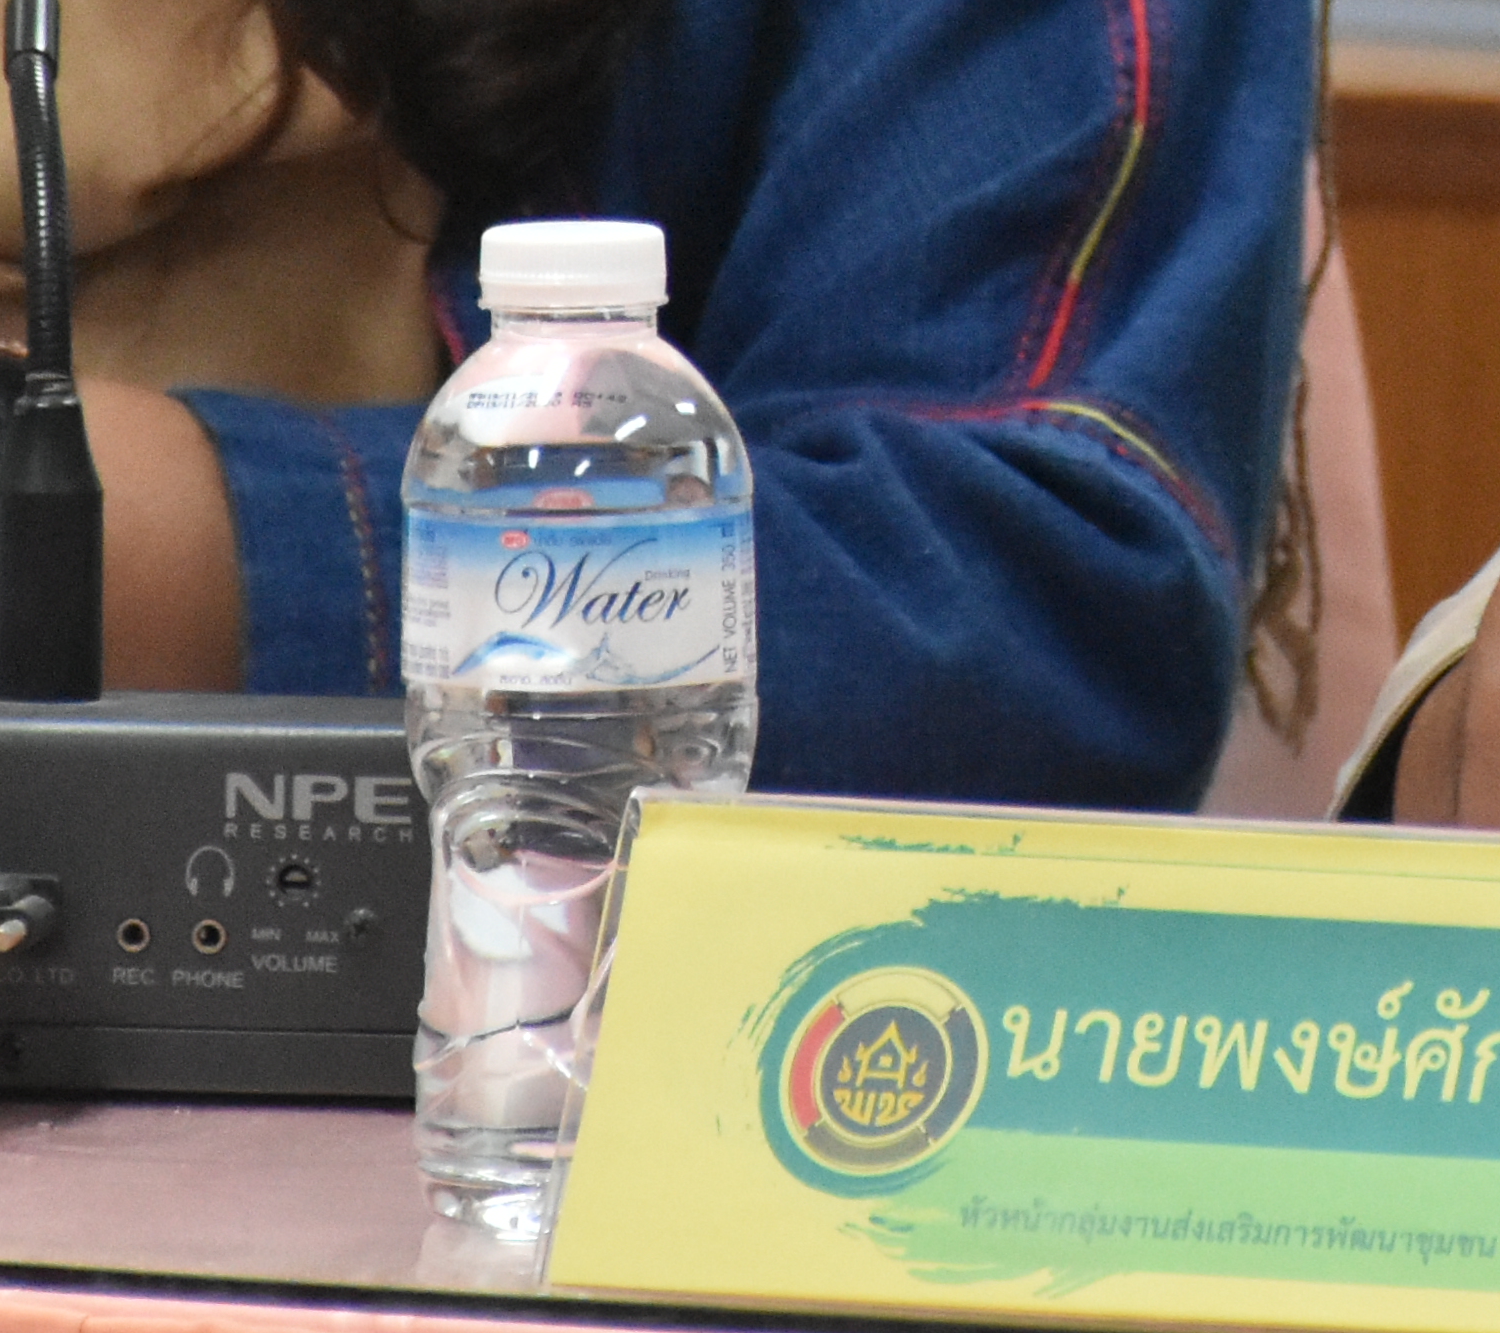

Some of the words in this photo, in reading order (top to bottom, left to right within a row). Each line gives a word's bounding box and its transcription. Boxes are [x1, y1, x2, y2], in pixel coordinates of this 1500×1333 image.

[495, 538, 689, 629] Water
[722, 579, 737, 639] VOLUME
[722, 646, 737, 673] NET
[225, 772, 412, 825] NPE
[224, 822, 414, 843] RESEARCH
[251, 928, 282, 942] MIN
[305, 930, 341, 944] MAX
[251, 954, 339, 974] VOLUME
[113, 967, 155, 985] REC
[172, 969, 245, 989] PHONE
